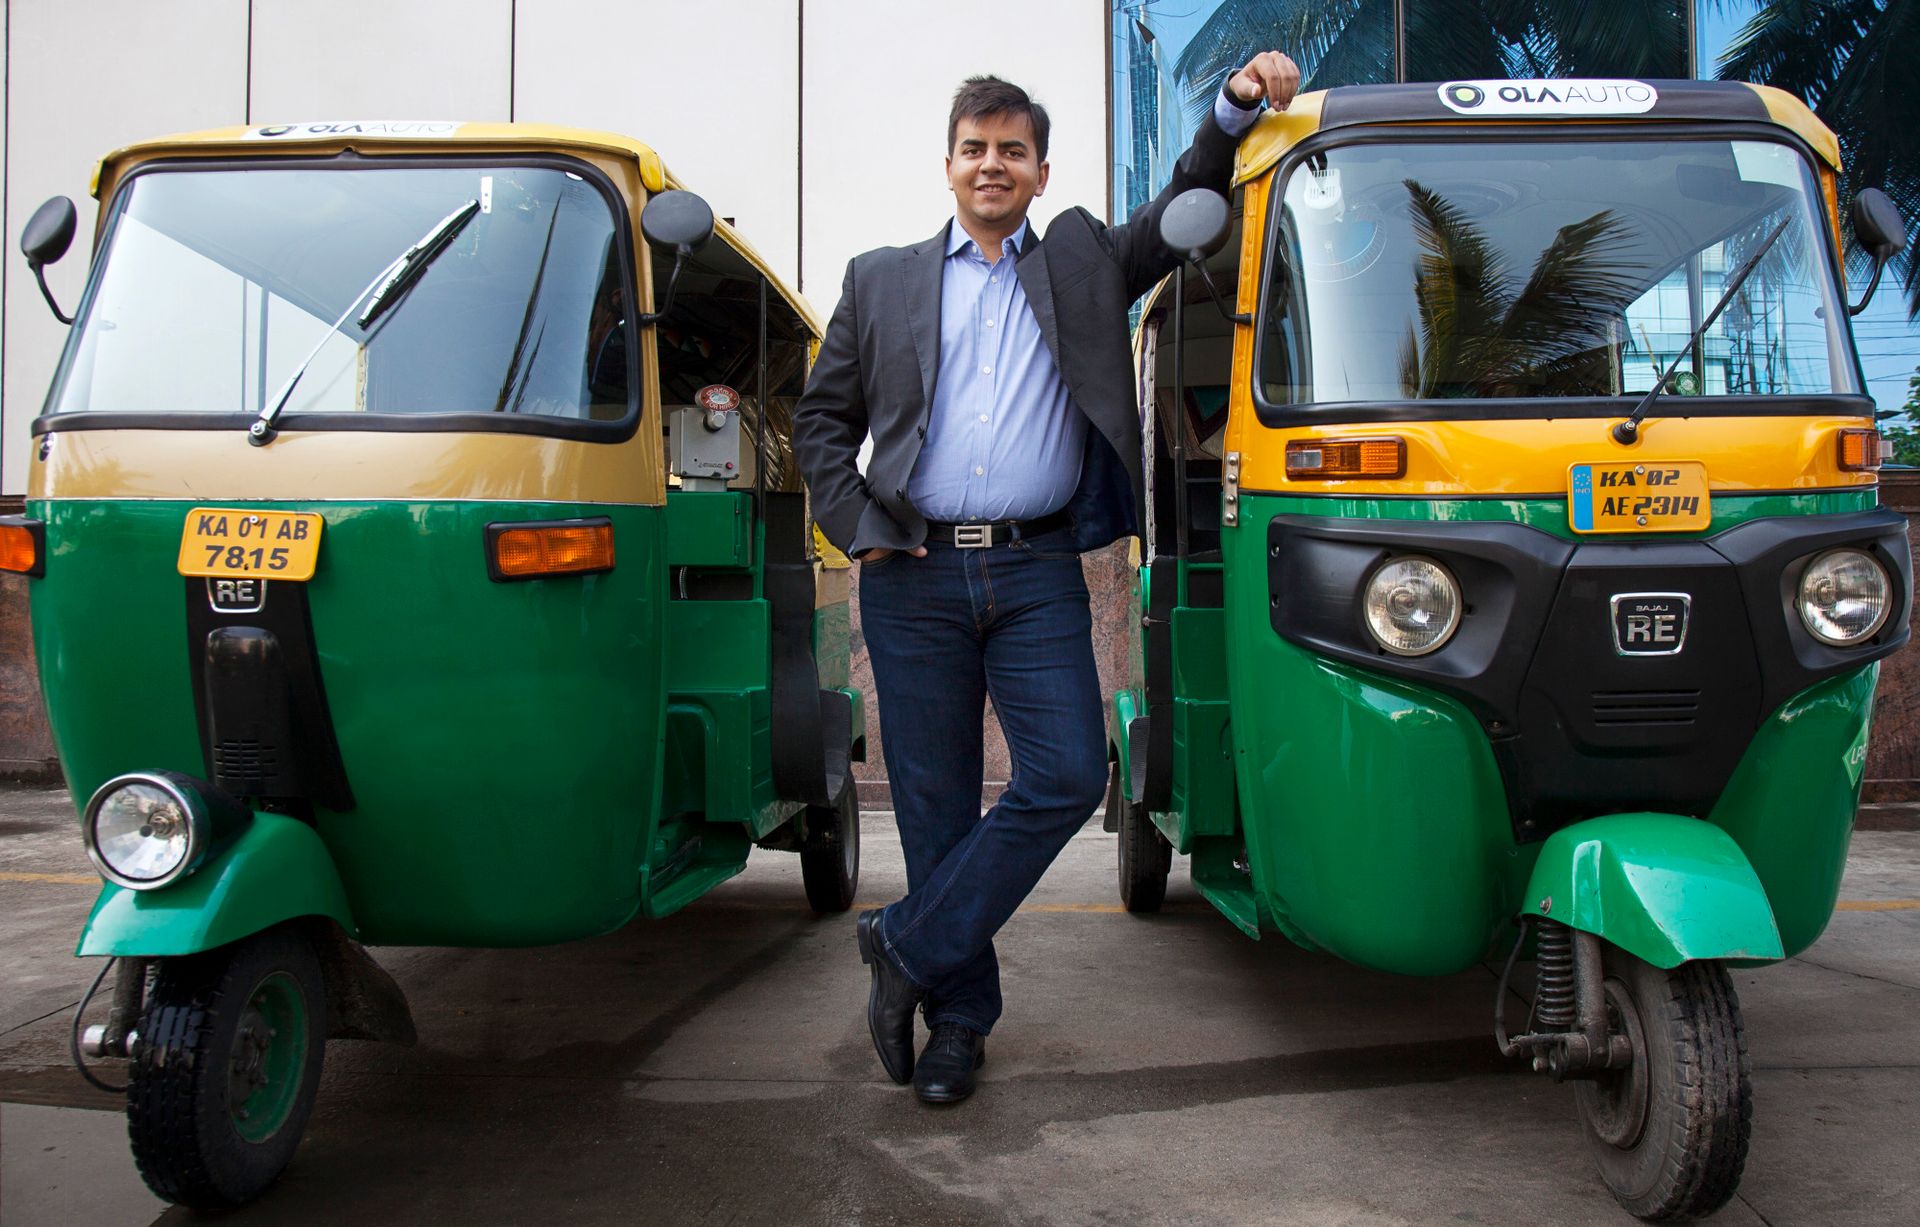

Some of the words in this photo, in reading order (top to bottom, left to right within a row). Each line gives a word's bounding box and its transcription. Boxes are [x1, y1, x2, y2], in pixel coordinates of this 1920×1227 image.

[1498, 86, 1561, 102] OLA
[1565, 86, 1650, 102] AUTO
[308, 124, 363, 133] OLA
[1600, 471, 1636, 487] KA
[1646, 470, 1680, 486] 02
[197, 515, 229, 537] KA
[238, 517, 268, 539] 01
[276, 519, 309, 540] AB
[205, 545, 289, 571] 7815
[216, 580, 255, 602] RE
[1626, 614, 1676, 642] RE
